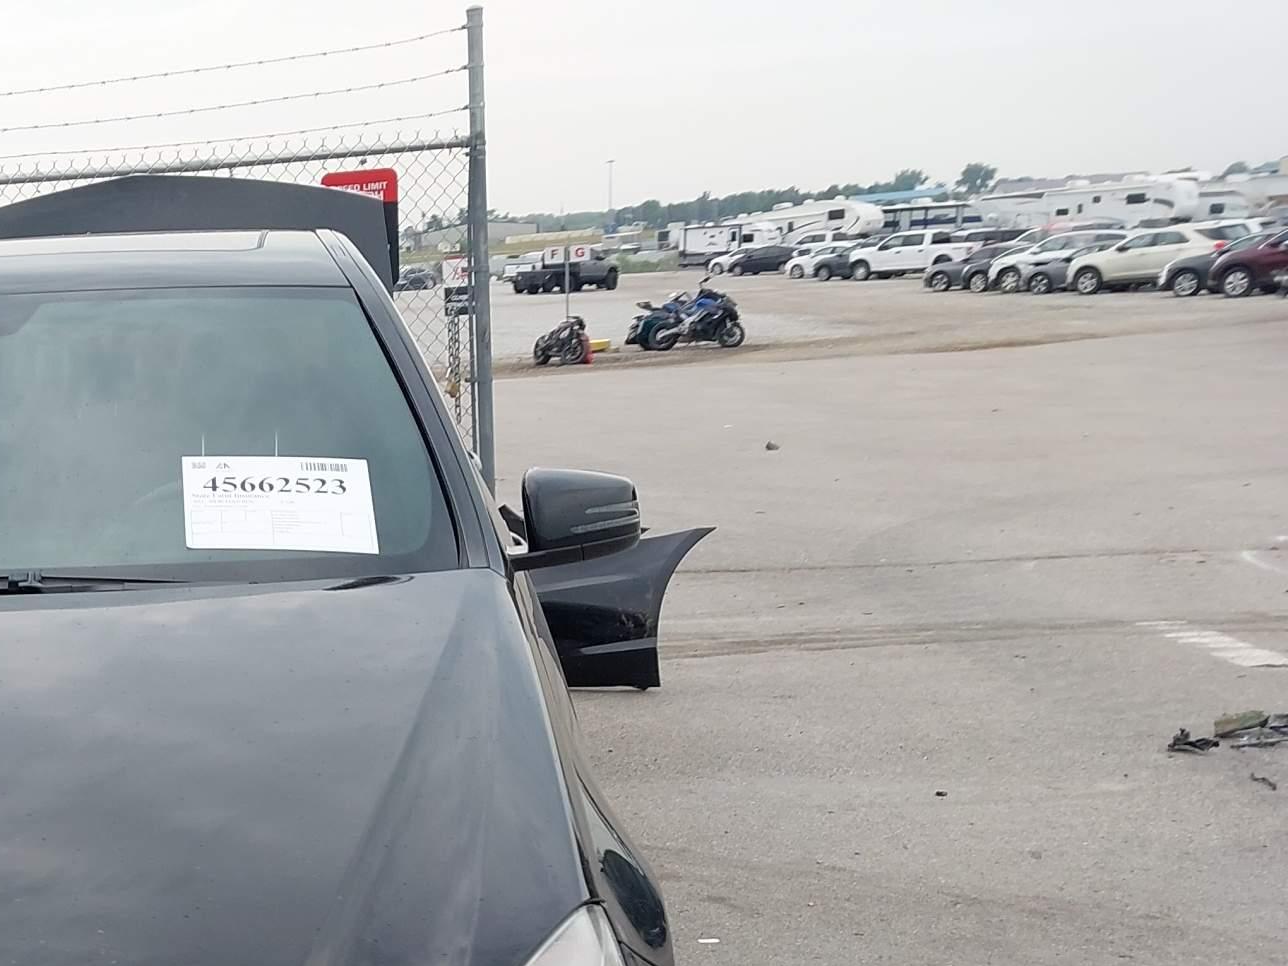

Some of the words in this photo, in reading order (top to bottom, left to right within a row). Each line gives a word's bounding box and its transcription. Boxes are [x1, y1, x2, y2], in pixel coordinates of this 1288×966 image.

[363, 181, 388, 191] LIMIT
[551, 248, 559, 259] F
[575, 247, 585, 258] G
[203, 476, 347, 495] 45662523
